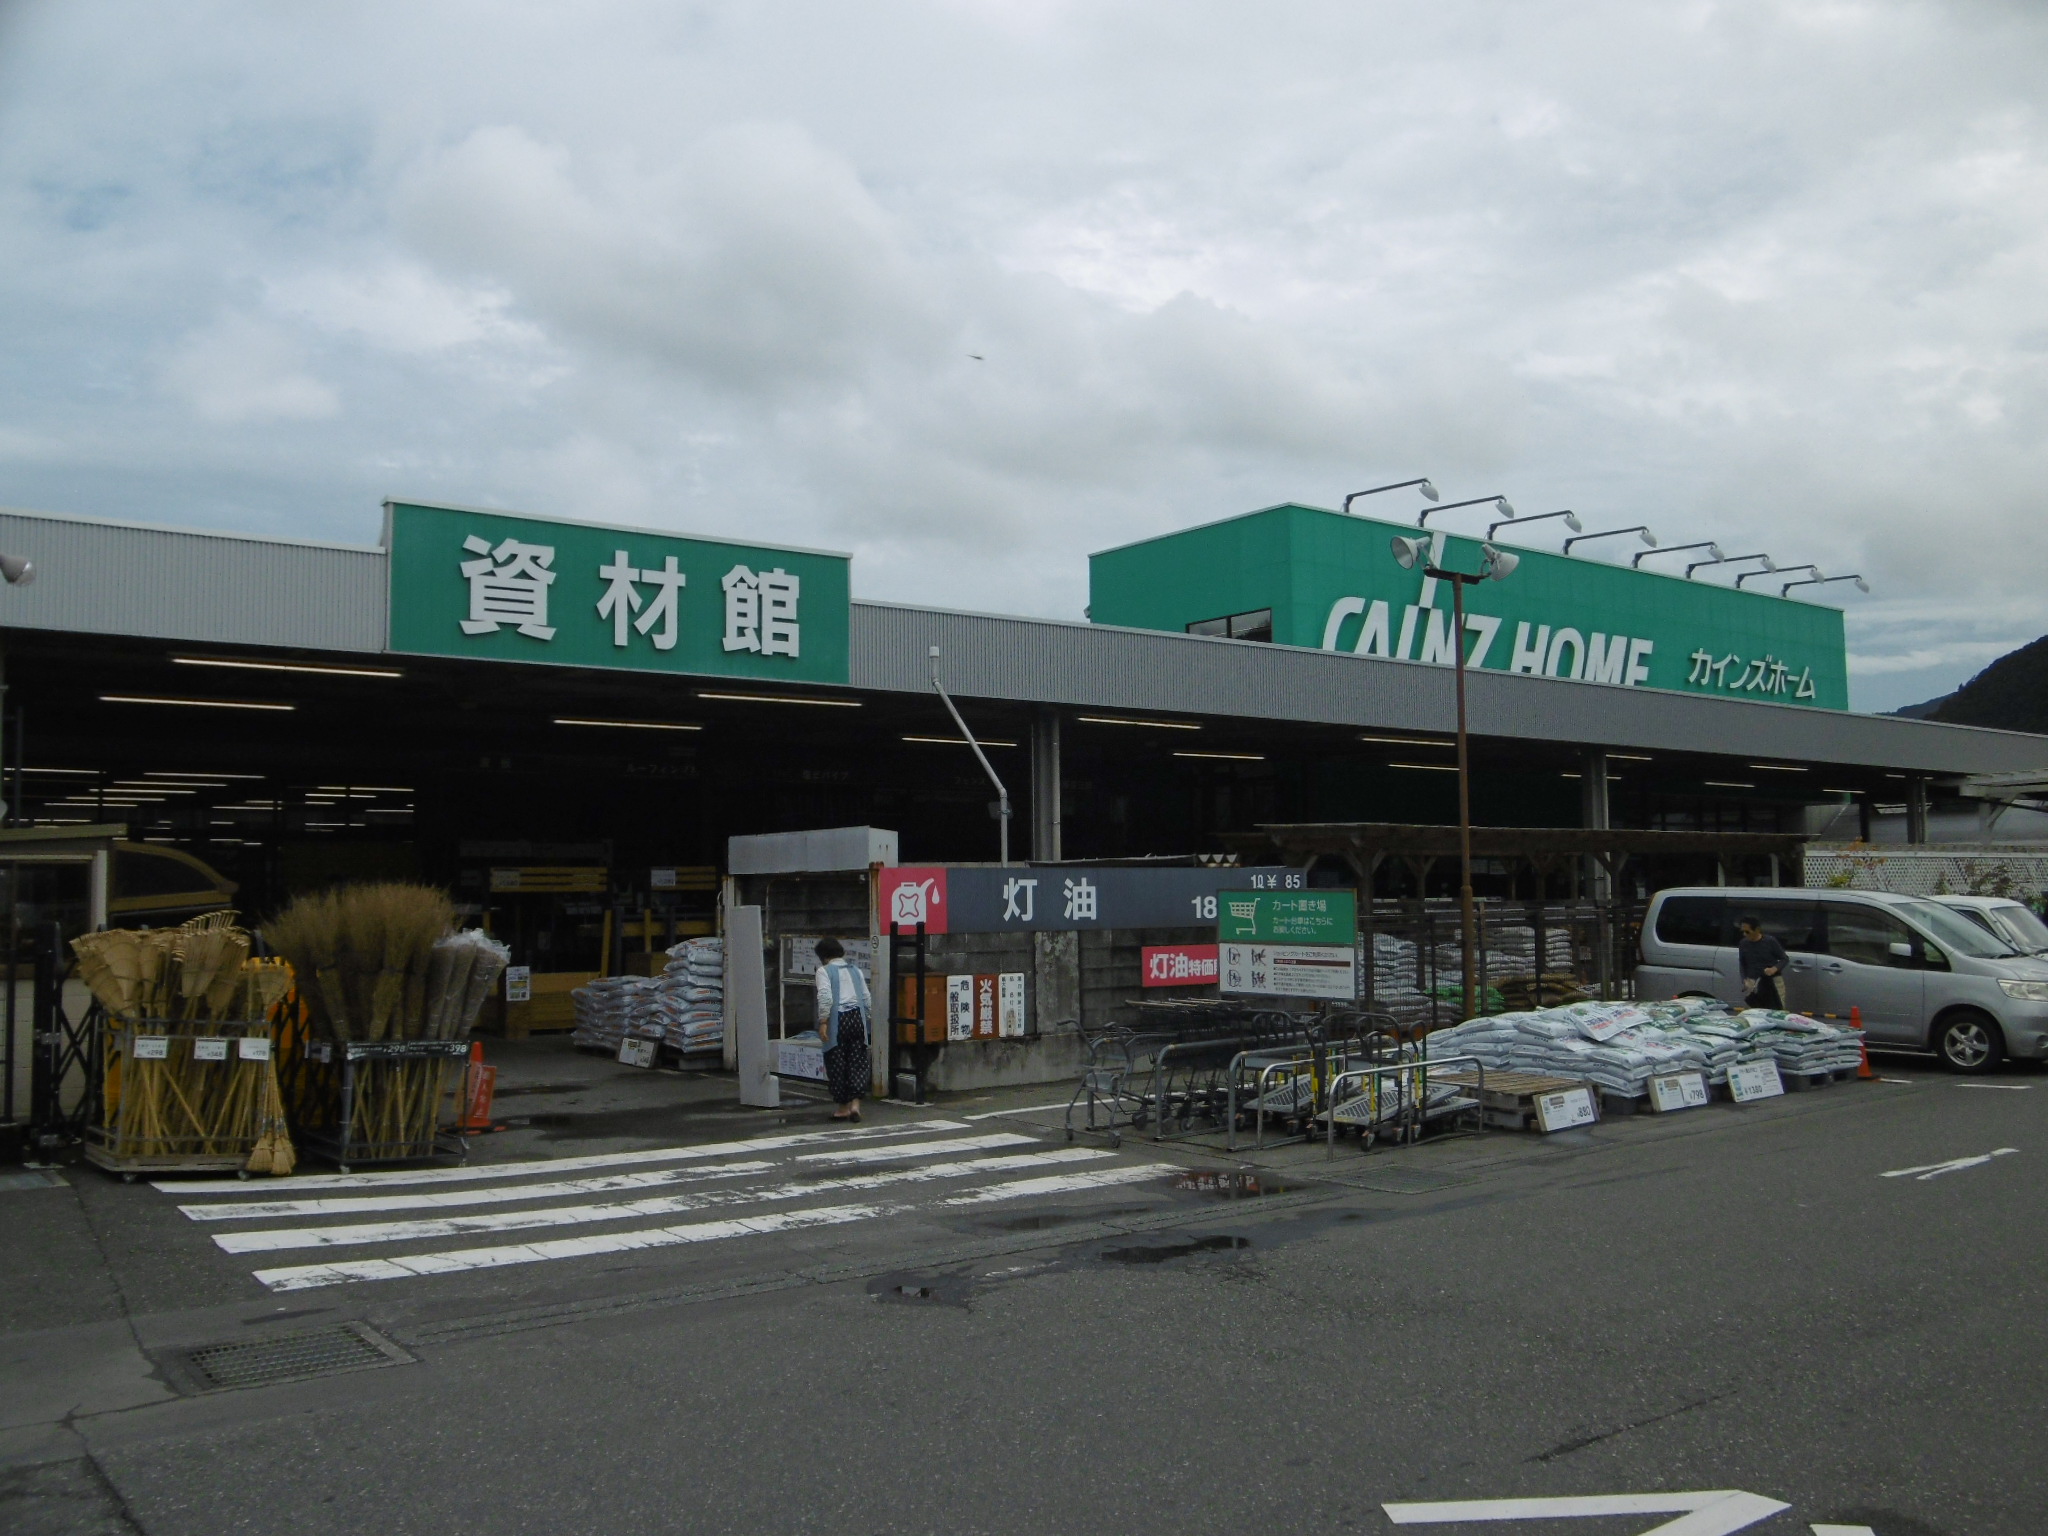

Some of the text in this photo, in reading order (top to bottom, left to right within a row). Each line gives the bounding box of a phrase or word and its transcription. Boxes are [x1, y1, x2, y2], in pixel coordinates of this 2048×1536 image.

[459, 535, 800, 658] 資材館
[1511, 621, 1654, 685] HOME
[1688, 648, 1816, 699] カインズホーム
[1002, 877, 1097, 922] 灯油
[1272, 899, 1327, 912] カート置き場
[1285, 874, 1301, 889] 85
[949, 983, 959, 1037] 一般取扱所
[960, 980, 971, 1035] 危険物
[979, 978, 993, 1035] 火気厳禁
